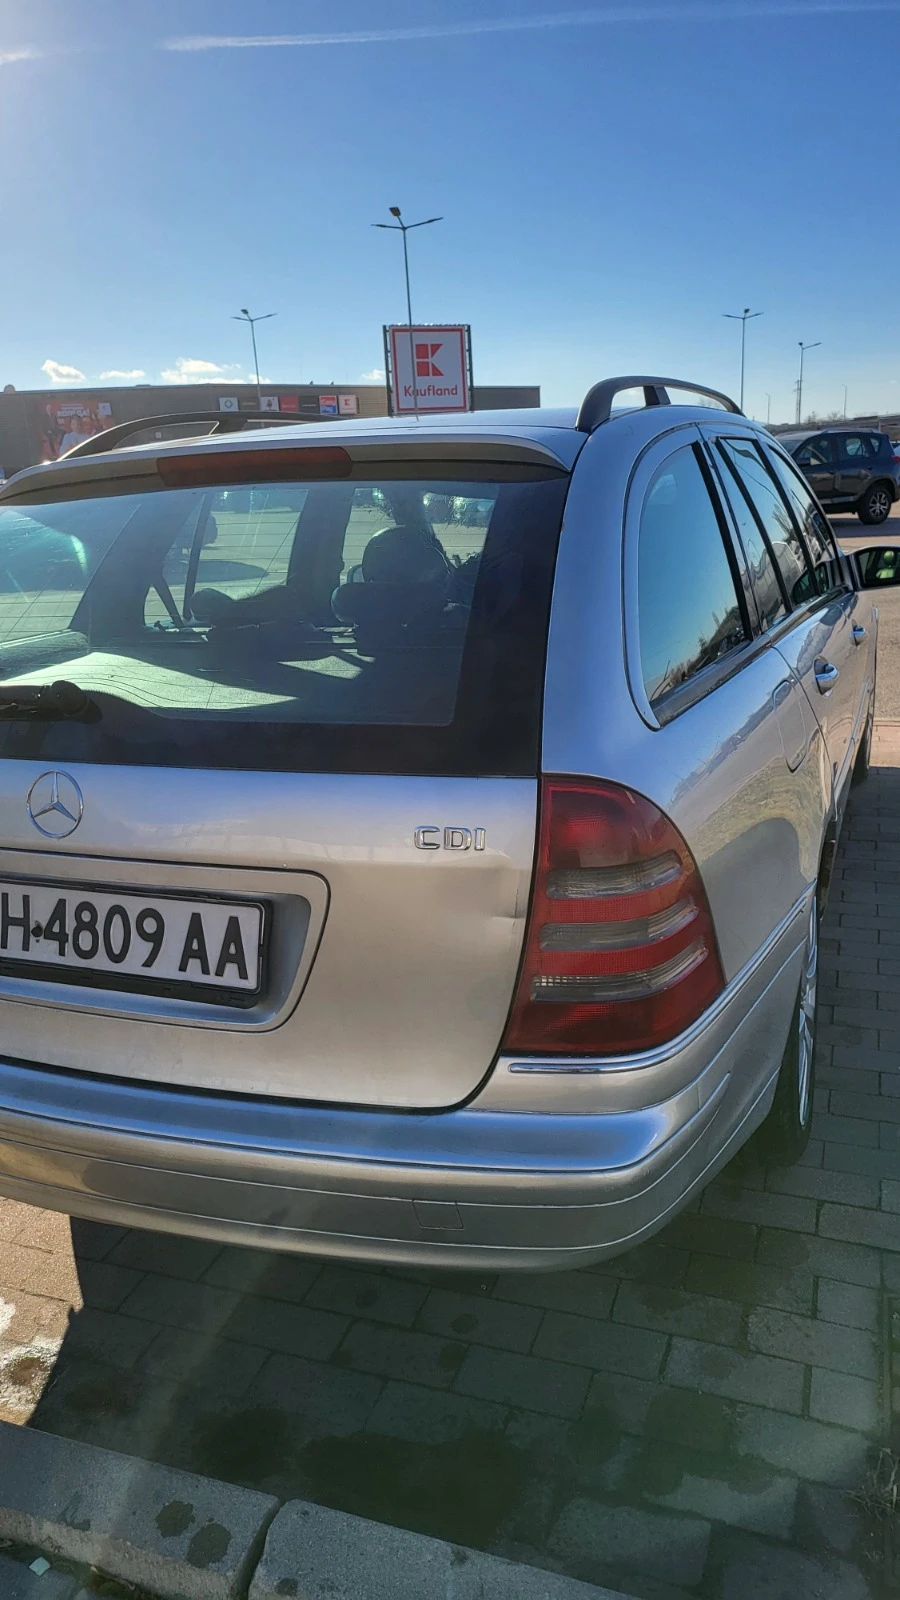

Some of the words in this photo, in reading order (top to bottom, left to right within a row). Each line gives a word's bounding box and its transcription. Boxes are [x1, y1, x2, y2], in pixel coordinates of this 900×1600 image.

[404, 384, 458, 398] Kaufland
[414, 825, 486, 851] CDI
[43, 898, 165, 968] 4809
[178, 911, 249, 980] AA
